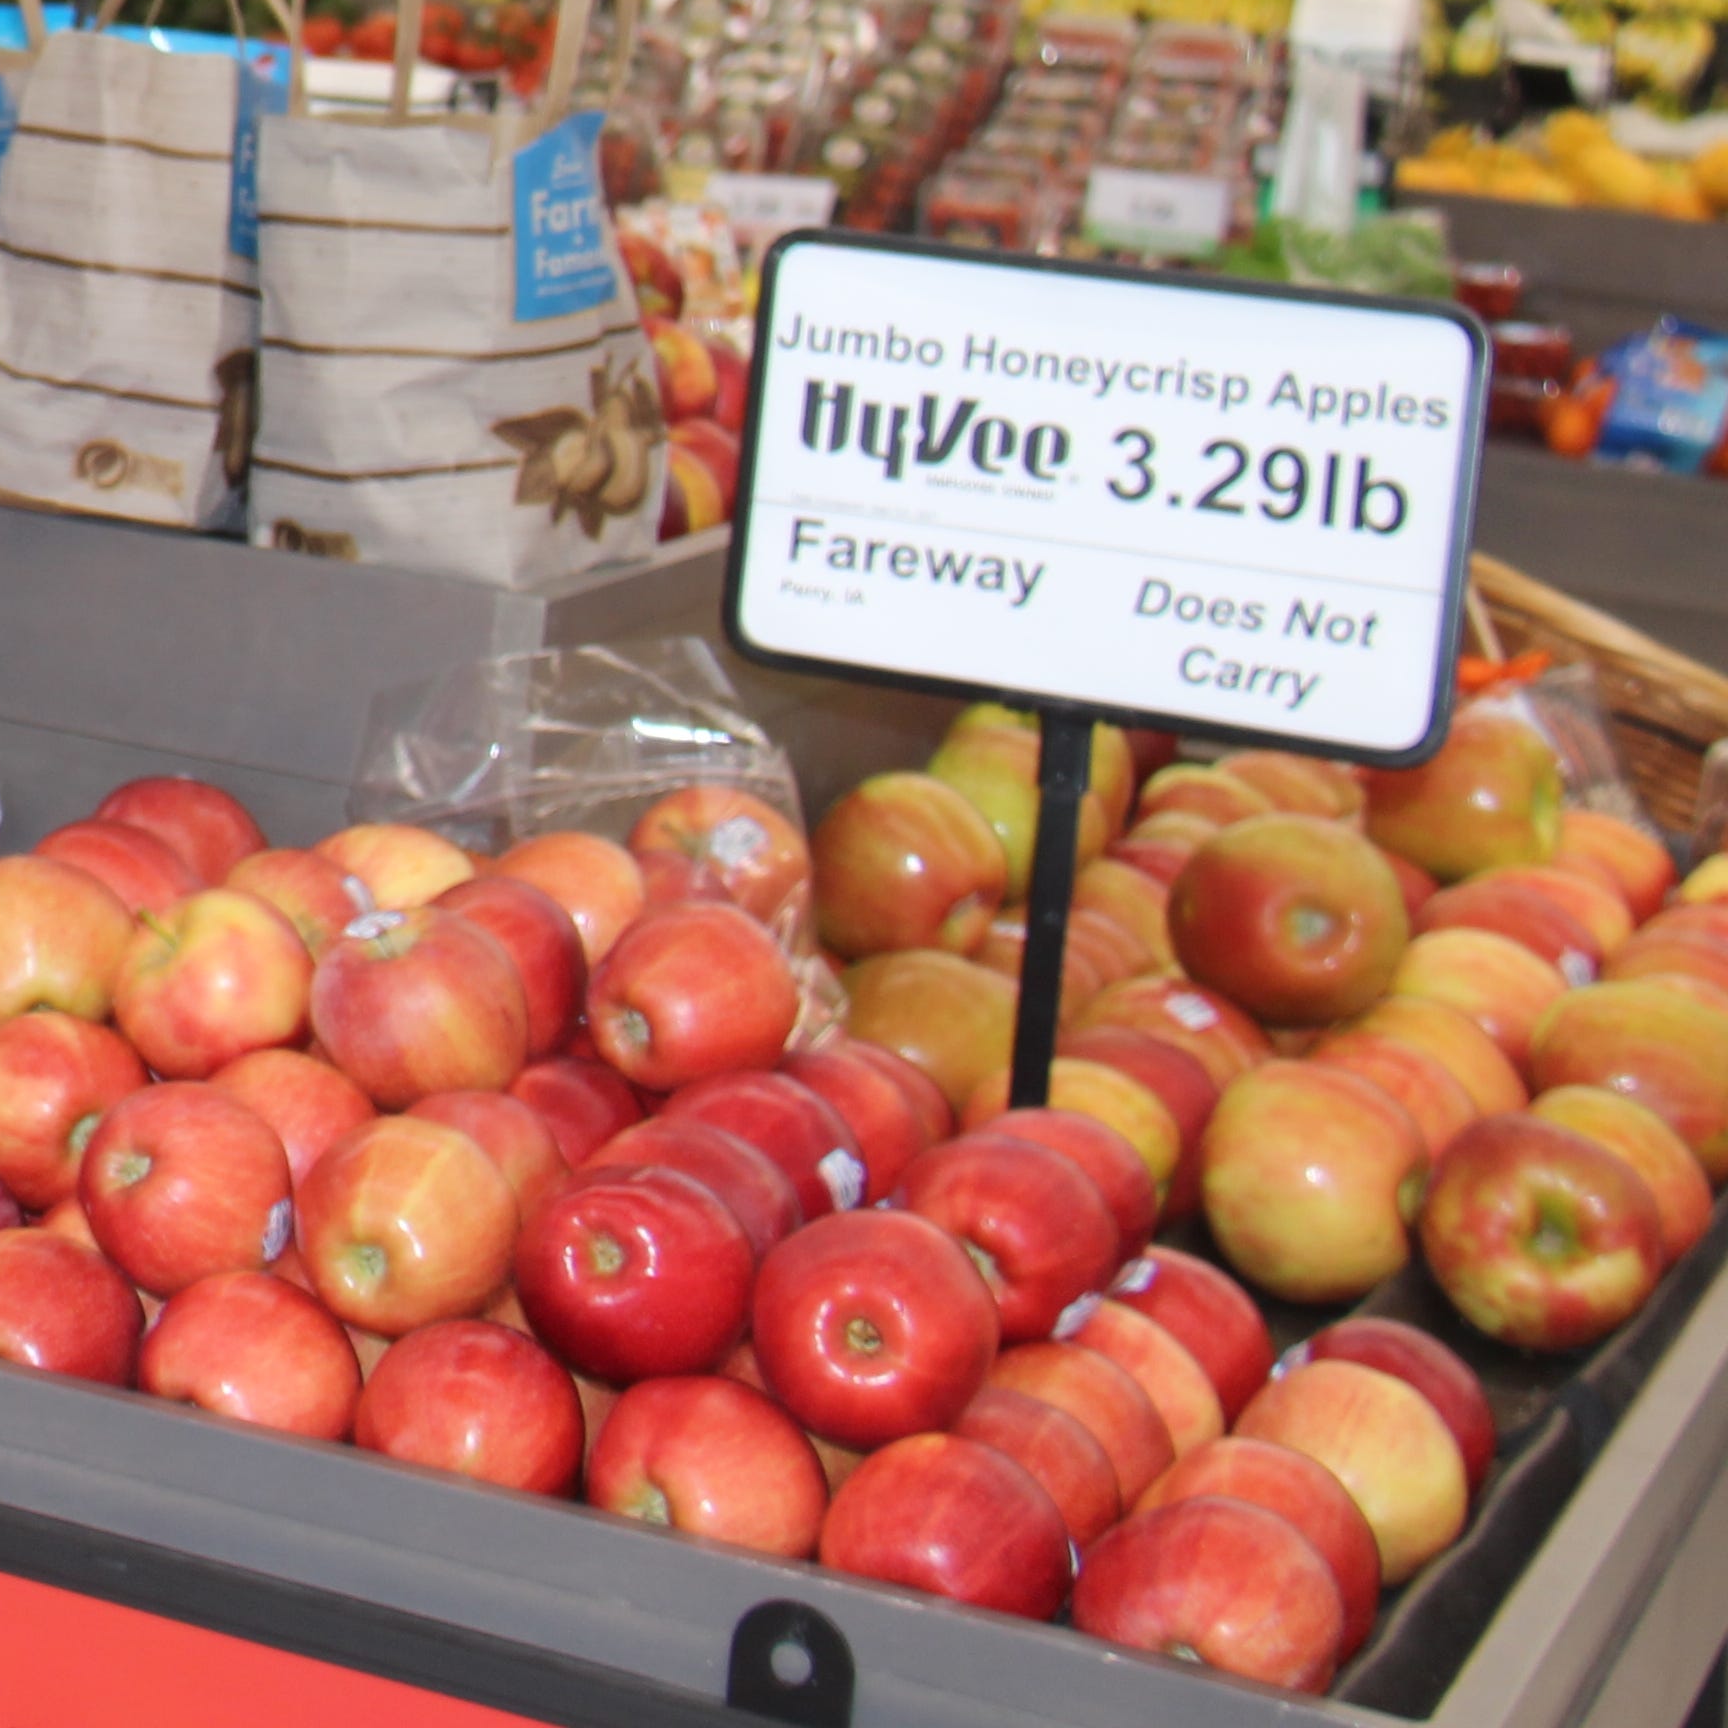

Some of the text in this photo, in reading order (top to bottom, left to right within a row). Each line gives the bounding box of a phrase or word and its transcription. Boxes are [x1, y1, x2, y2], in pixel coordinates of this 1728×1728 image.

[776, 314, 1451, 430] Jumbo Honeycrisp Apples
[1105, 428, 1410, 538] 3.29lb
[787, 517, 1046, 608] Fareway
[1136, 578, 1380, 652] Does Not
[1178, 646, 1321, 712] Carry
